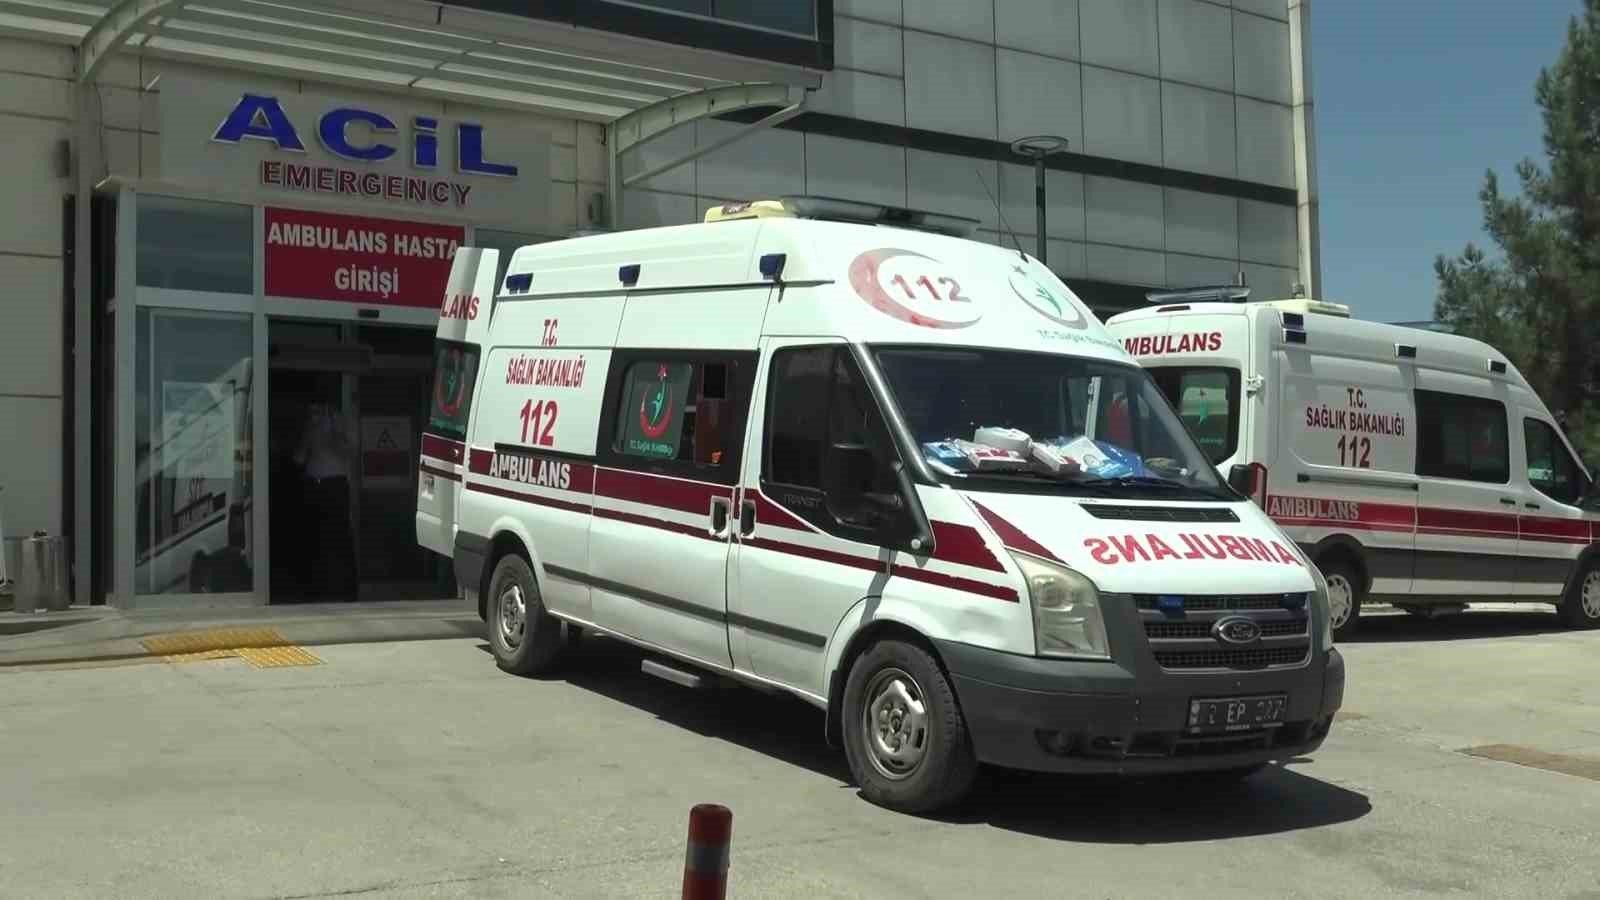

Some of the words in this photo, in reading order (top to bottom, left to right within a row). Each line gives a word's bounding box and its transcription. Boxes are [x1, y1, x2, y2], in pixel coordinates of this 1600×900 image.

[261, 160, 472, 207] EMERGENCY
[267, 222, 388, 255] AMBULANS
[393, 232, 458, 260] HASTA
[890, 274, 972, 303] 112
[1118, 331, 1222, 356] MBULANS
[506, 353, 537, 385] SAĞLIK
[536, 354, 586, 389] BAKANLIĞI
[1346, 387, 1367, 409] T.C.
[519, 398, 558, 447] 112
[1306, 404, 1346, 430] SAĞLIK
[1349, 411, 1405, 437] BAKANLIĞI
[1337, 434, 1371, 468] 112
[488, 452, 571, 490] AMBULANS
[1269, 495, 1360, 520] AMBULANS
